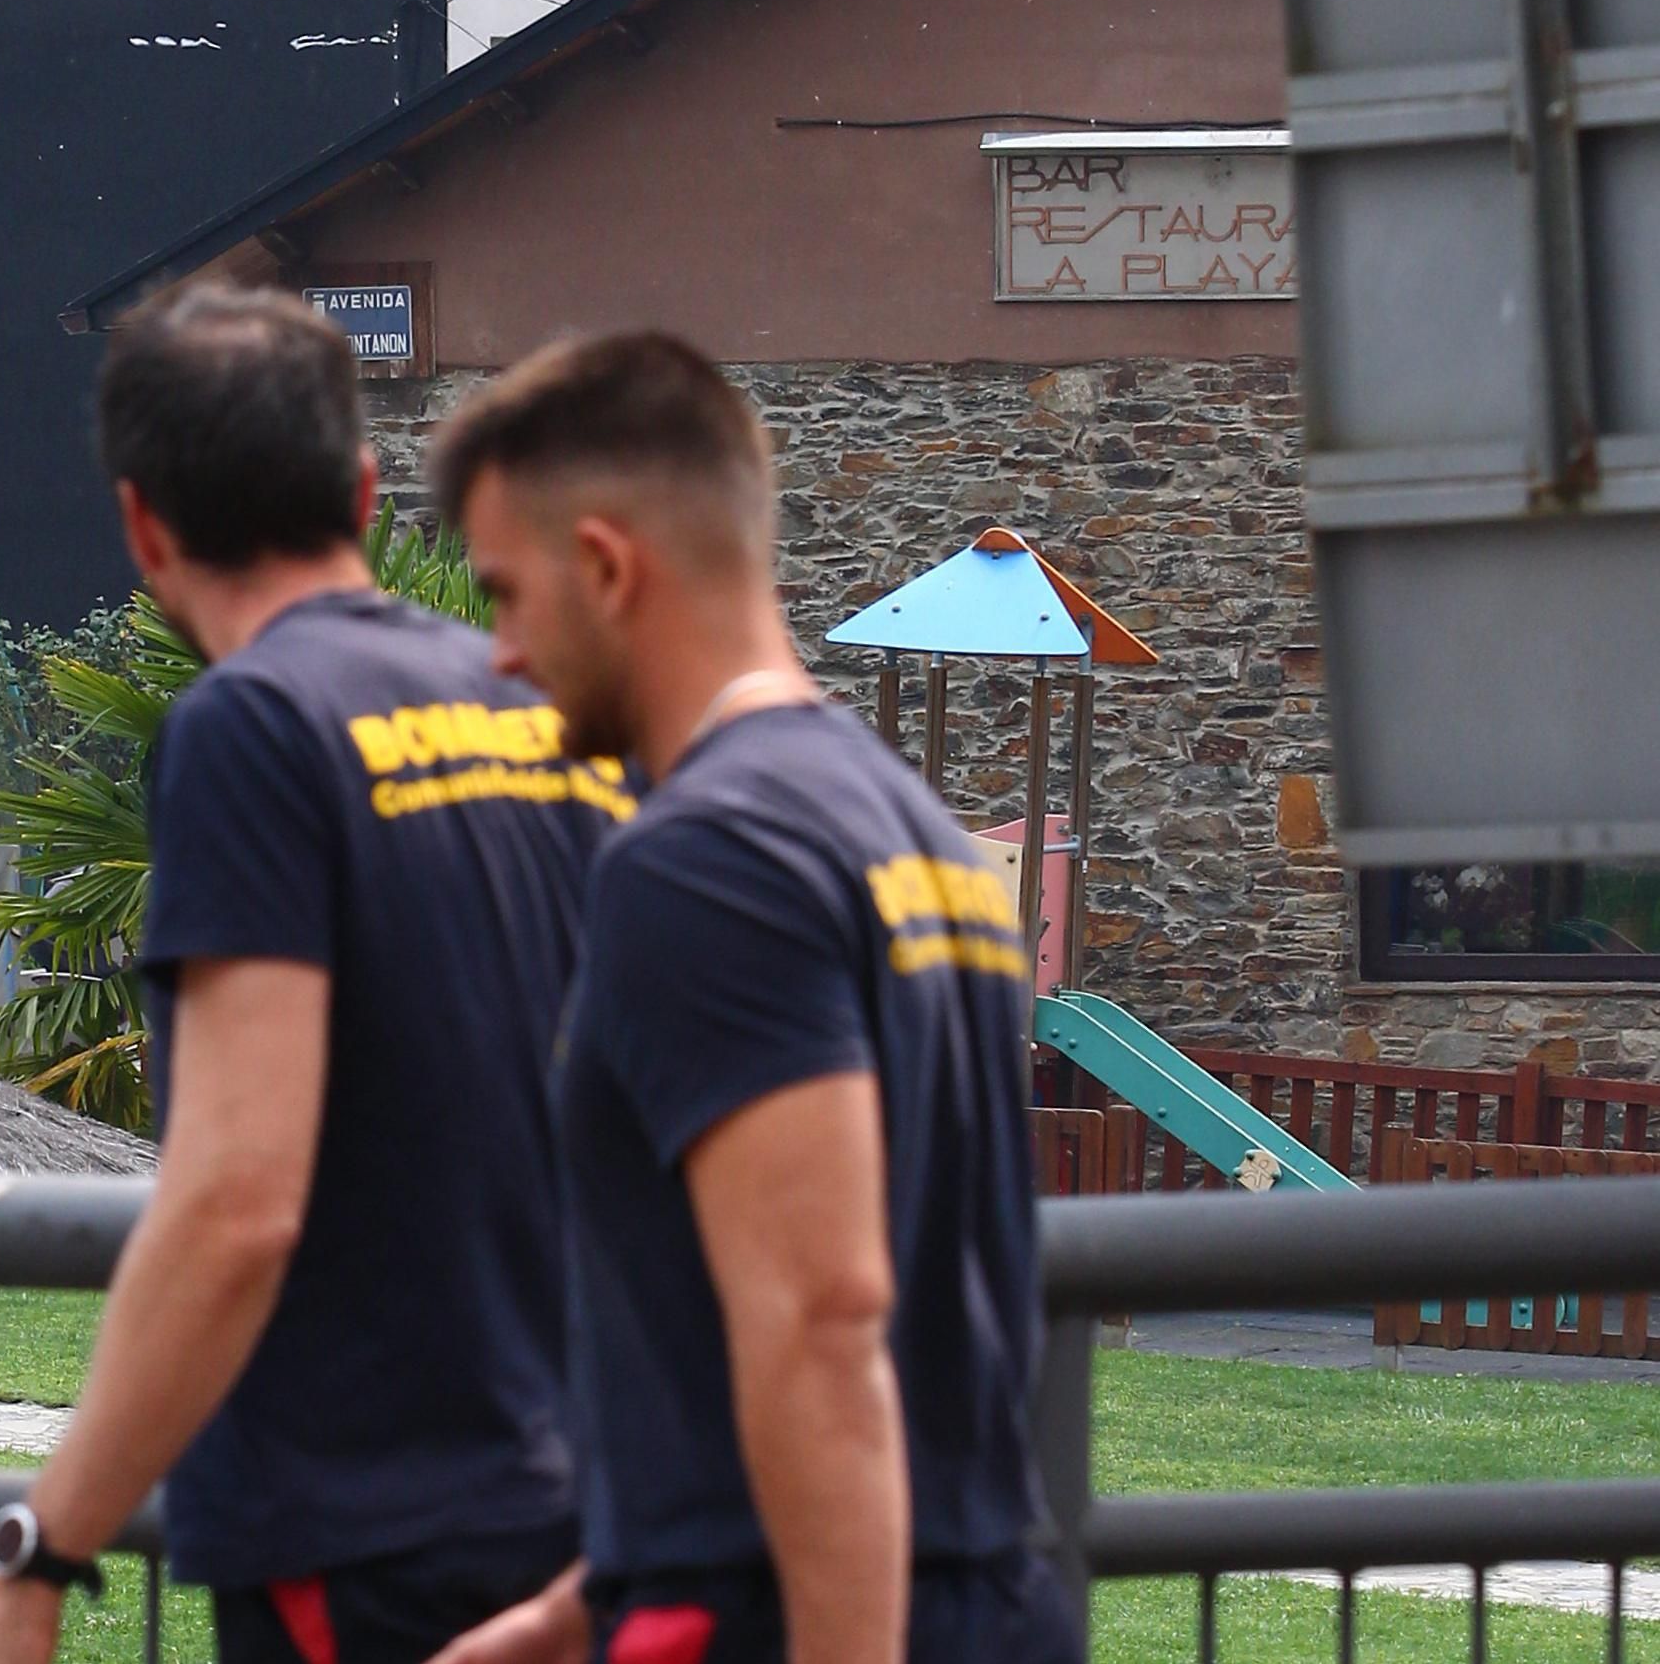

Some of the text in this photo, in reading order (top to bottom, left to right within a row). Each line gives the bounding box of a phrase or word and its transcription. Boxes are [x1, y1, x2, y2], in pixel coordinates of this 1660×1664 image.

[1007, 156, 1125, 193] BAR
[1007, 204, 1298, 243] RESTAURA
[1007, 255, 1086, 293] LA
[329, 292, 406, 309] AVENIDA
